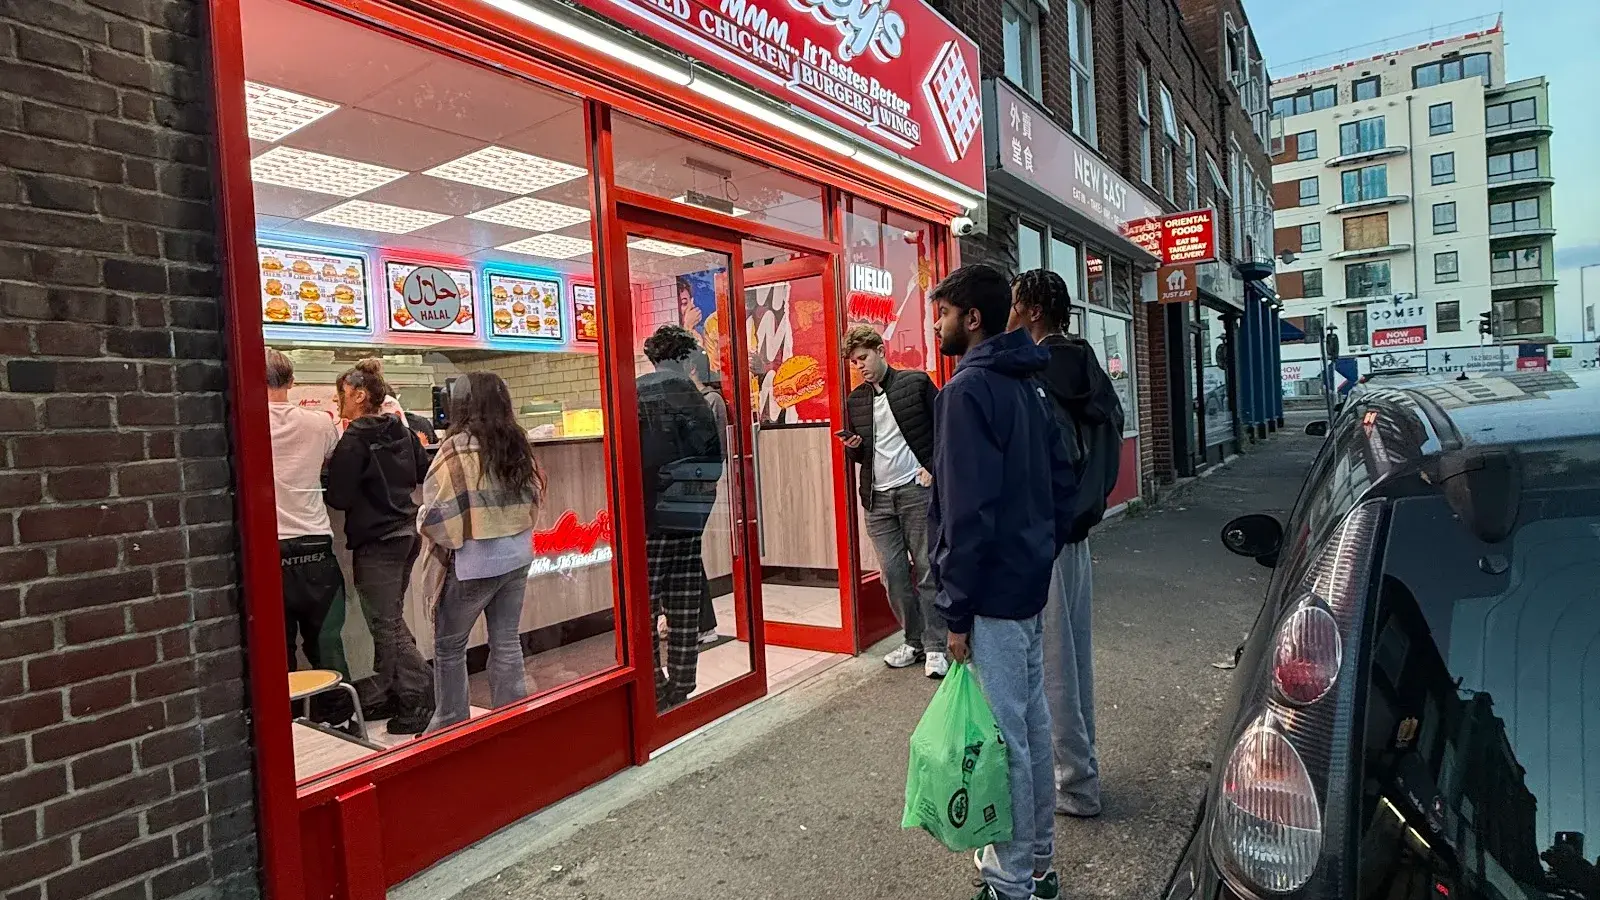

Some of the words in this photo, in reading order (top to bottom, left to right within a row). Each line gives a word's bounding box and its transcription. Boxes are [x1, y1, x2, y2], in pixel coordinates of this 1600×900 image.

[699, 9, 791, 74] CHICKEN
[800, 63, 874, 117] BURGERS
[878, 105, 920, 142] WINGS
[803, 37, 819, 65] It
[818, 46, 870, 94] Tastes
[869, 76, 912, 117] Better
[1074, 150, 1100, 193] NEW
[1102, 172, 1128, 213] EAST
[1165, 214, 1210, 228] ORIENTAL
[1171, 224, 1204, 237] FOODS
[1175, 238, 1189, 246] EAT
[1190, 236, 1199, 244] IN
[1168, 242, 1207, 254] TAKEAWAY
[1170, 250, 1206, 261] DELIVERY
[856, 264, 893, 297] HELLO
[408, 273, 457, 307] حلال
[1162, 291, 1178, 299] JUST
[1179, 289, 1192, 297] EAT
[420, 309, 451, 321] HALAL
[1370, 306, 1424, 321] COMET
[1386, 330, 1409, 339] NOW
[1374, 336, 1422, 347] LAUNCHED
